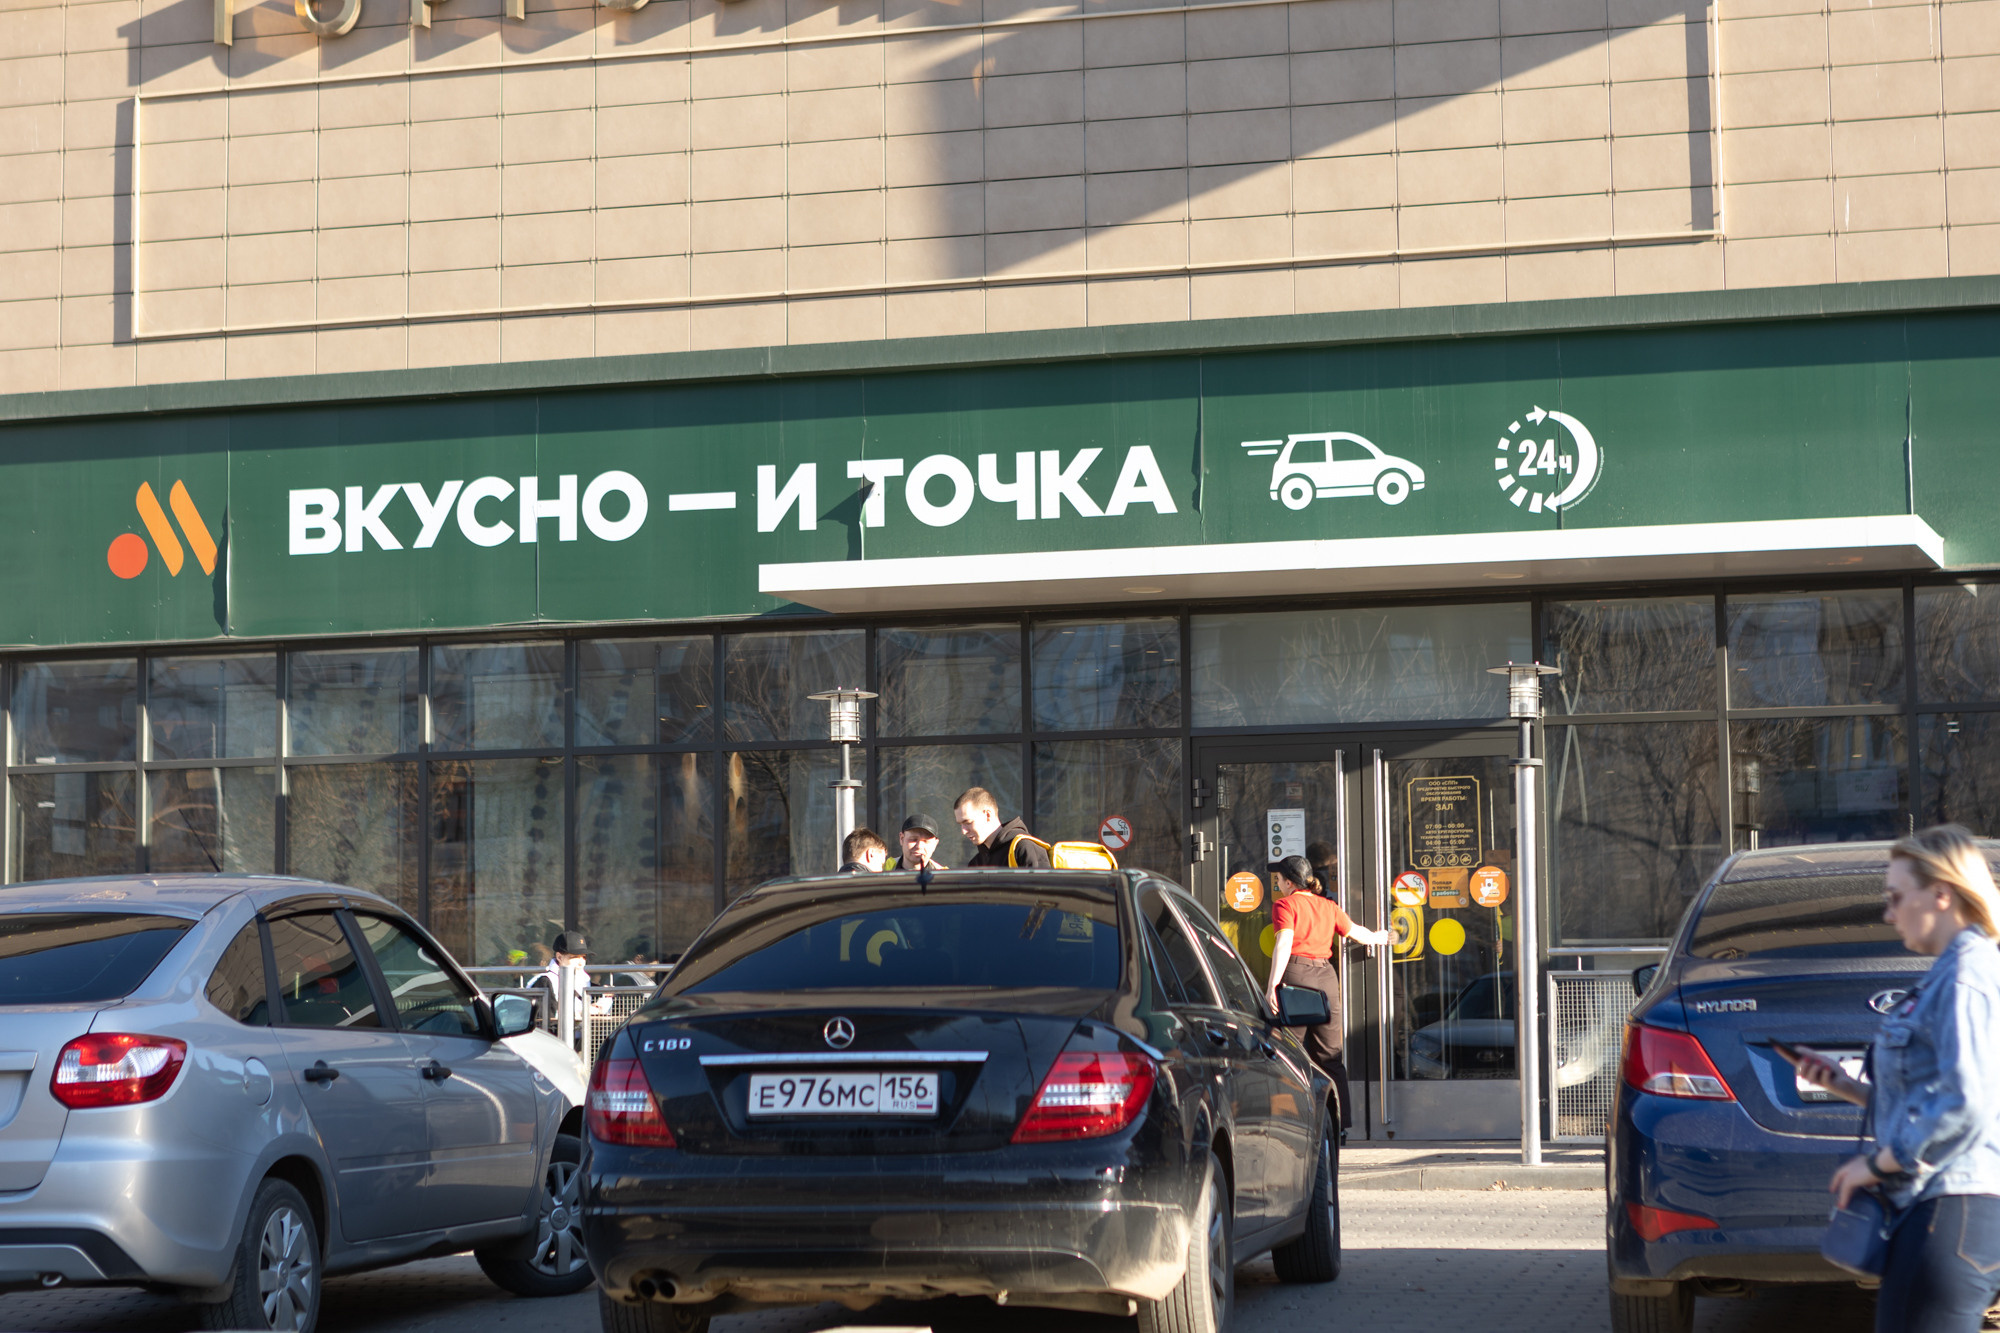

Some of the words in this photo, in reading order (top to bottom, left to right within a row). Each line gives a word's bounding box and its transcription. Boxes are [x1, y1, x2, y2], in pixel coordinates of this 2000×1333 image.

[289, 470, 648, 556] ВКУСНО
[757, 462, 817, 532] И
[847, 445, 1178, 527] ТОЧКА
[1435, 803, 1454, 811] ЗАЛ
[1696, 998, 1757, 1013] HYUNDAI
[658, 1038, 692, 1051] 180
[884, 1076, 928, 1099] 156
[892, 1100, 915, 1110] RUS
